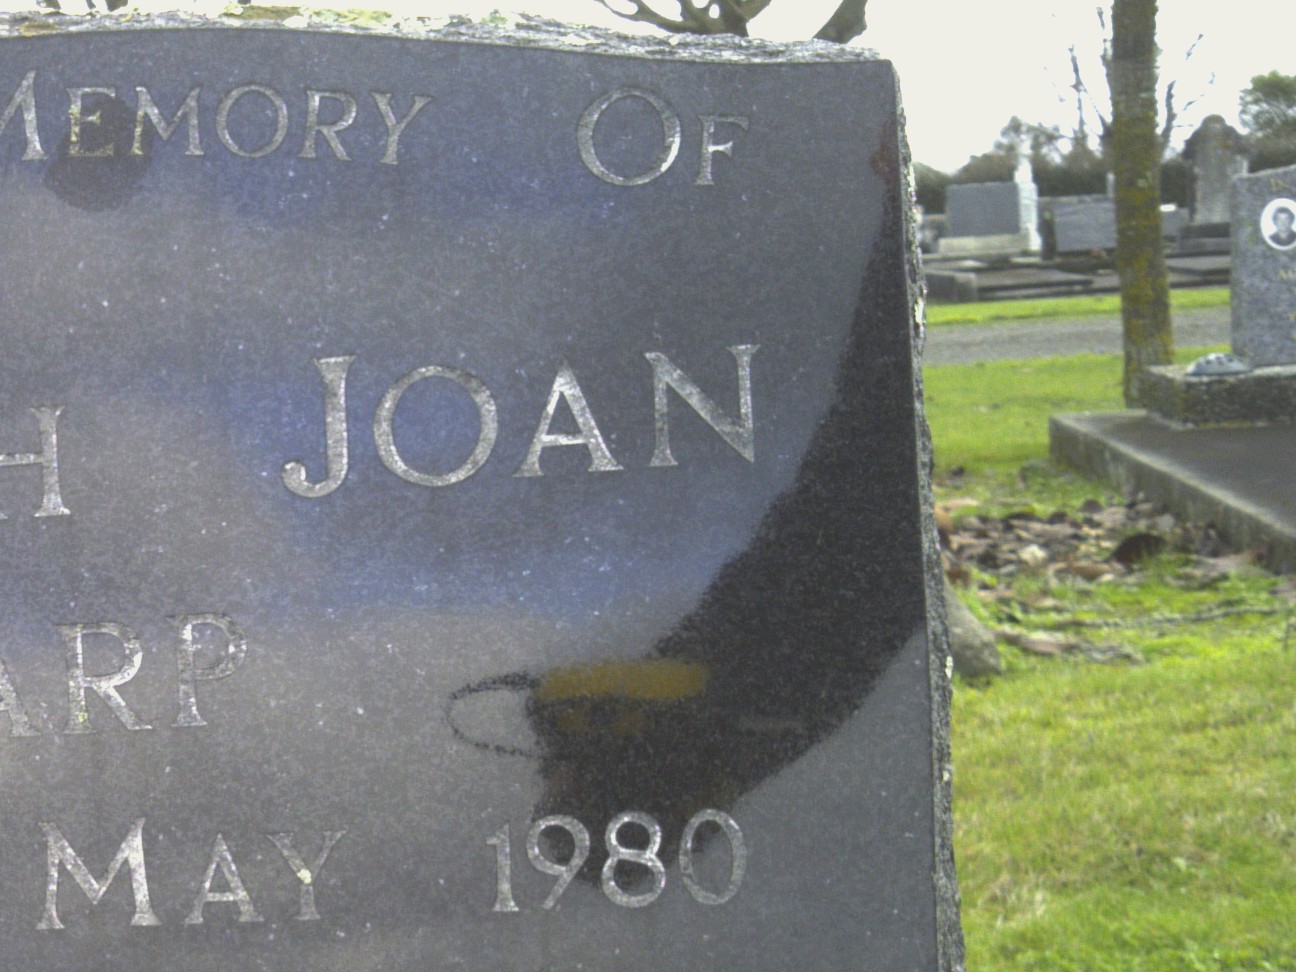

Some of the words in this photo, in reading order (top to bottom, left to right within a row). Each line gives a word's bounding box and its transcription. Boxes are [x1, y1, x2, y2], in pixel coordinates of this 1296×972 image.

[576, 86, 749, 187] OF
[281, 343, 762, 498] JOAN
[35, 816, 348, 931] MAY
[485, 808, 748, 913] 1980
